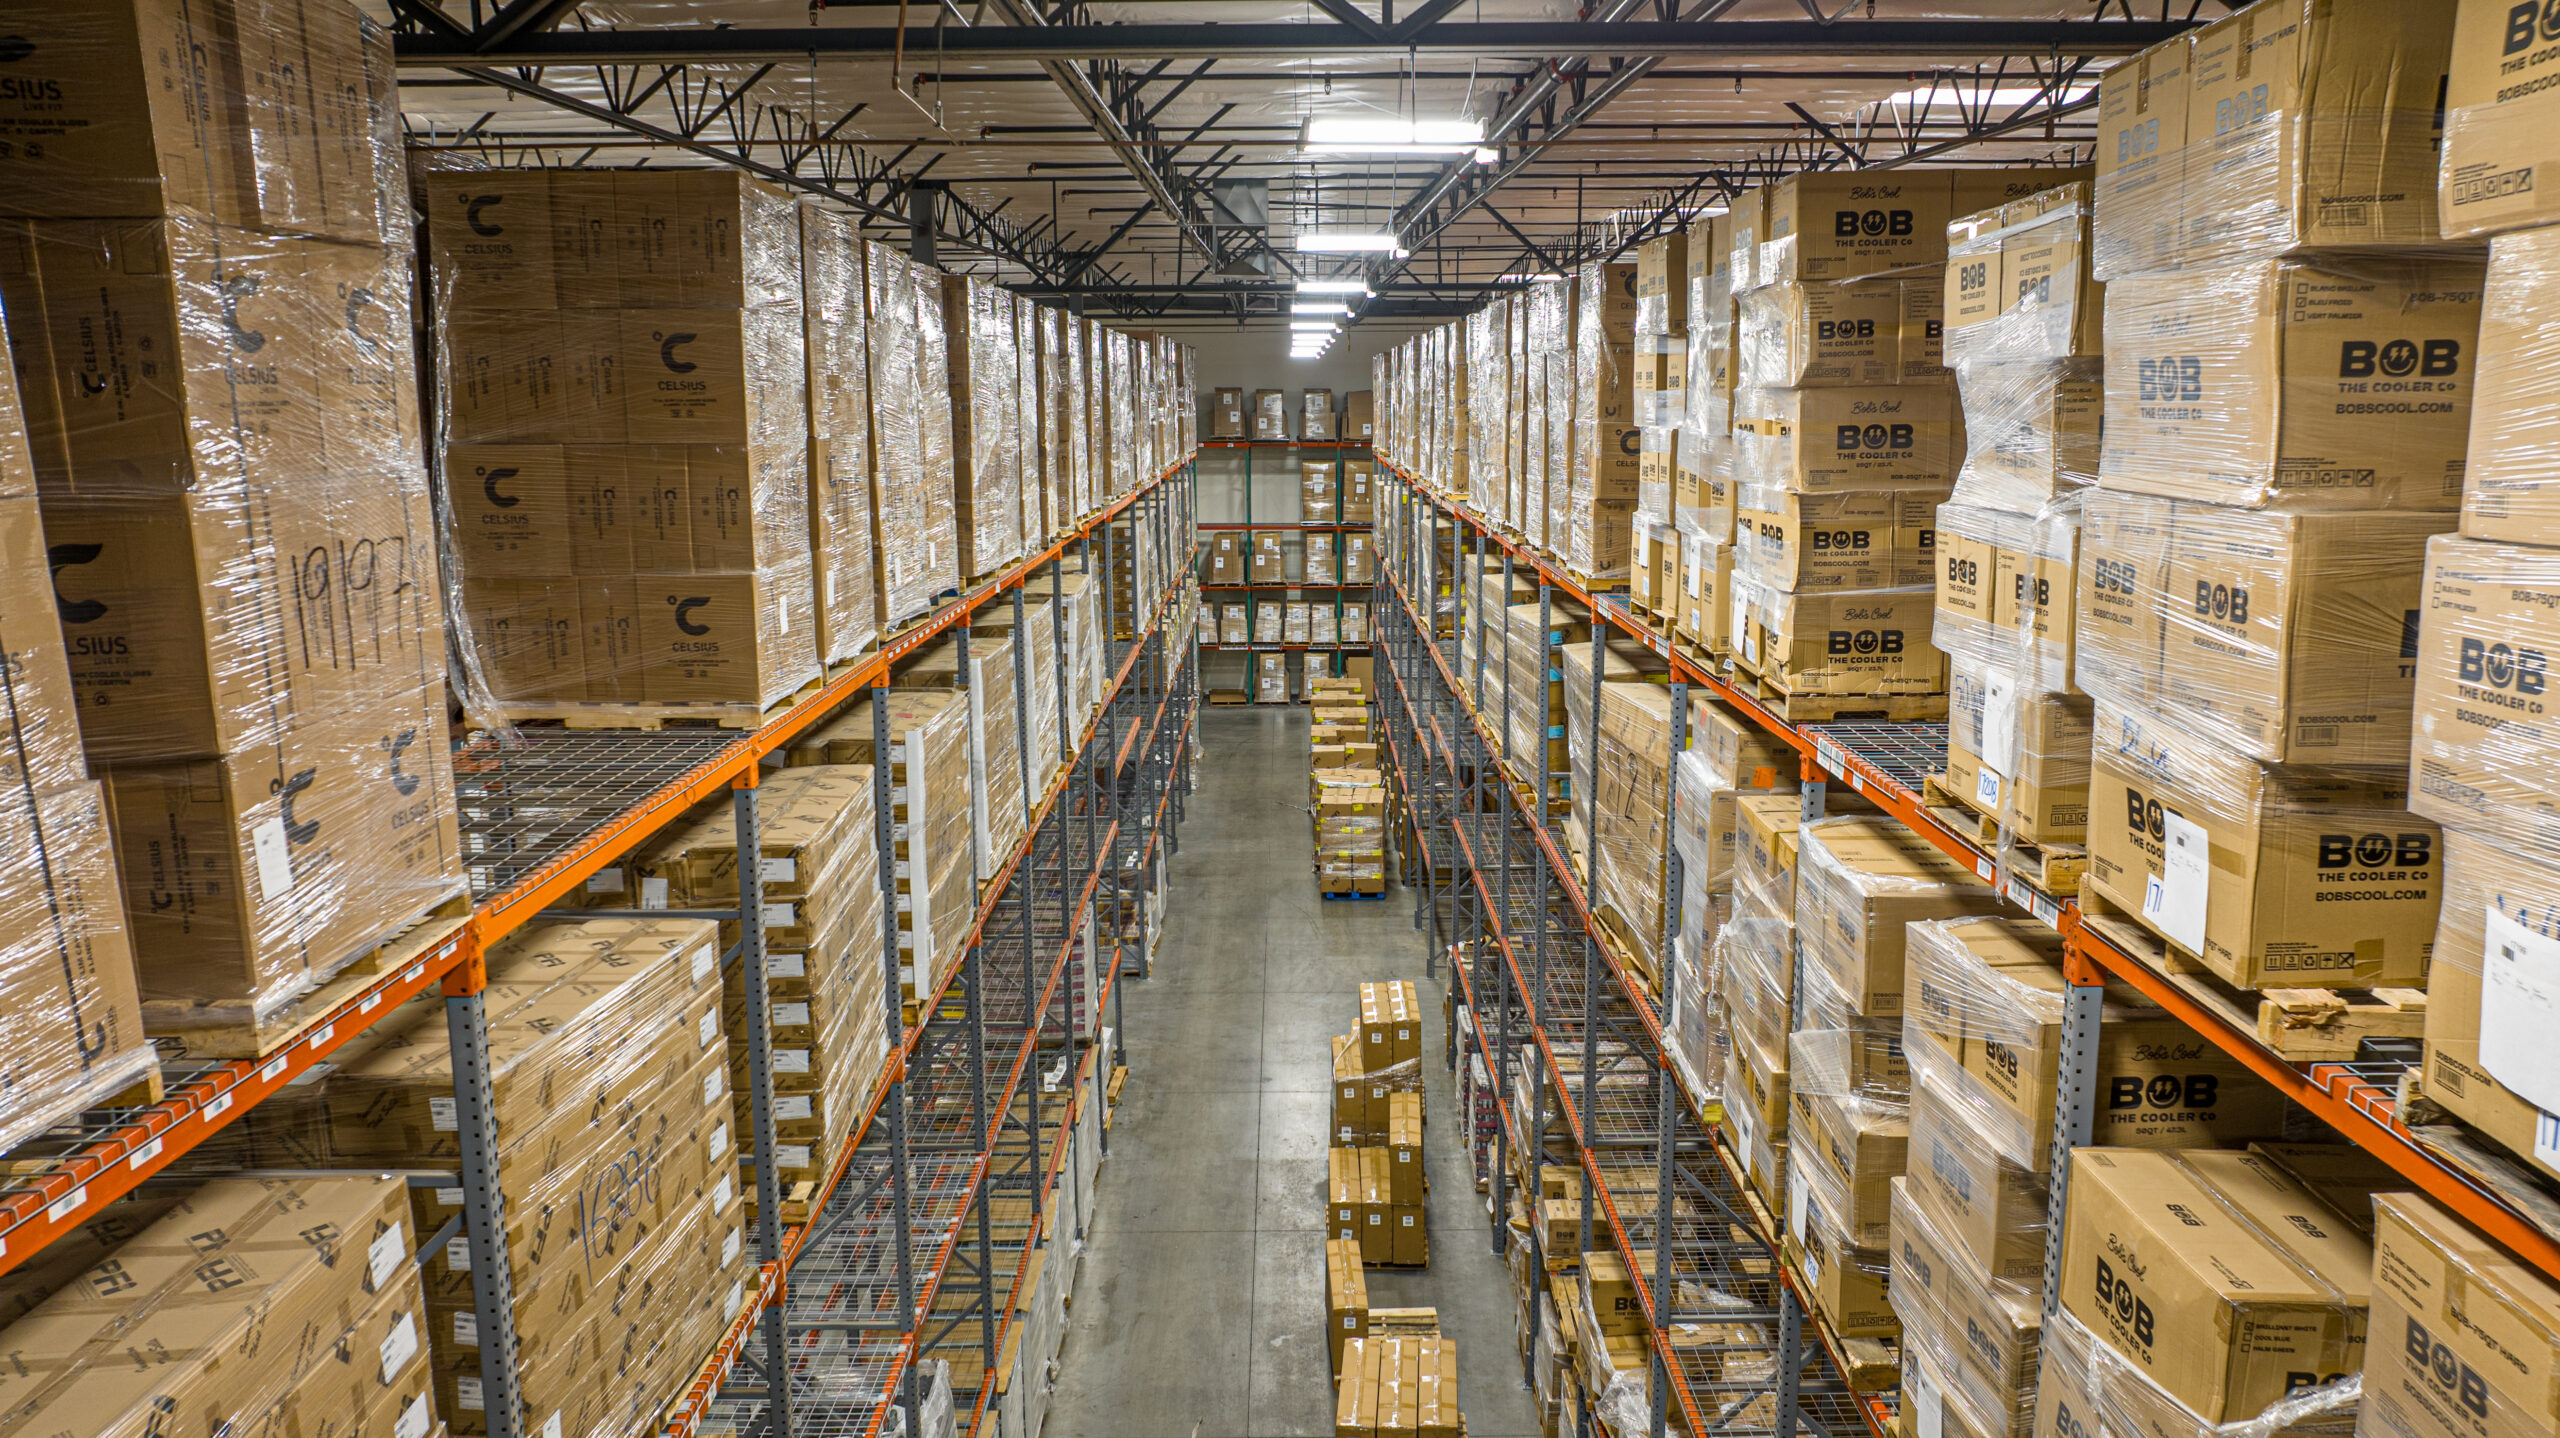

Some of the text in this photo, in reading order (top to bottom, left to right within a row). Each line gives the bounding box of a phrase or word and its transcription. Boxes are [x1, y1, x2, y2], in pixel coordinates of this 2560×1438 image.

[2501, 56, 2526, 76] THE
[2216, 83, 2268, 137] BOB
[2118, 118, 2159, 163] BOB
[1878, 186, 1902, 198] Cool
[1835, 210, 1913, 237] BOB
[465, 244, 512, 254] CELSIUS
[1836, 239, 1854, 247] THE
[1857, 239, 1898, 247] COOLER
[1960, 262, 1986, 291] BOB
[1818, 320, 1874, 340] BOB
[79, 317, 97, 371] CELSIUS
[2340, 339, 2459, 377] BOB
[658, 380, 705, 391] CELSIUS
[2139, 356, 2202, 401] BOB
[2338, 383, 2368, 393] THE
[2373, 382, 2432, 392] COOLER
[1880, 400, 1902, 413] Cool
[2336, 402, 2453, 415] BOBSCOOL.COM
[1837, 424, 1913, 450] BOB
[482, 514, 528, 525] CELSIUS
[1814, 531, 1869, 549] BOB
[1949, 557, 1977, 585] BOB
[2095, 558, 2135, 595] BOB
[1871, 608, 1893, 620] Cool
[2196, 580, 2248, 624] BOB
[672, 642, 719, 652] CELSIUS
[1829, 630, 1903, 655] BOB
[2460, 637, 2546, 695] BOB
[2458, 685, 2478, 700] THE
[2482, 690, 2524, 711] COOLER
[2129, 832, 2144, 849] THE
[2318, 832, 2431, 869] BOB
[2318, 872, 2345, 882] THE
[2349, 871, 2406, 881] COOLER
[2316, 890, 2427, 902] BOBSCOOL.COM
[1985, 1032, 2018, 1078] BOB
[2131, 1043, 2204, 1062] Bob's Cool
[2109, 1074, 2218, 1110] BOB
[2110, 1114, 2136, 1124] THE
[2141, 1112, 2195, 1122] COOLER
[2166, 1204, 2201, 1227] BOB
[2288, 1216, 2328, 1238] BOB
[1904, 1240, 1931, 1288] BOB
[2106, 1233, 2147, 1282] Bob's Cool
[2096, 1255, 2154, 1348] BOB
[2095, 1295, 2109, 1319] THE
[2110, 1315, 2141, 1354] COOLER
[1968, 1316, 2000, 1373] BOB
[2406, 1315, 2488, 1418] BOB
[2500, 1345, 2529, 1375] HARD
[2405, 1356, 2424, 1380] THE
[2428, 1377, 2469, 1419] COOLER
